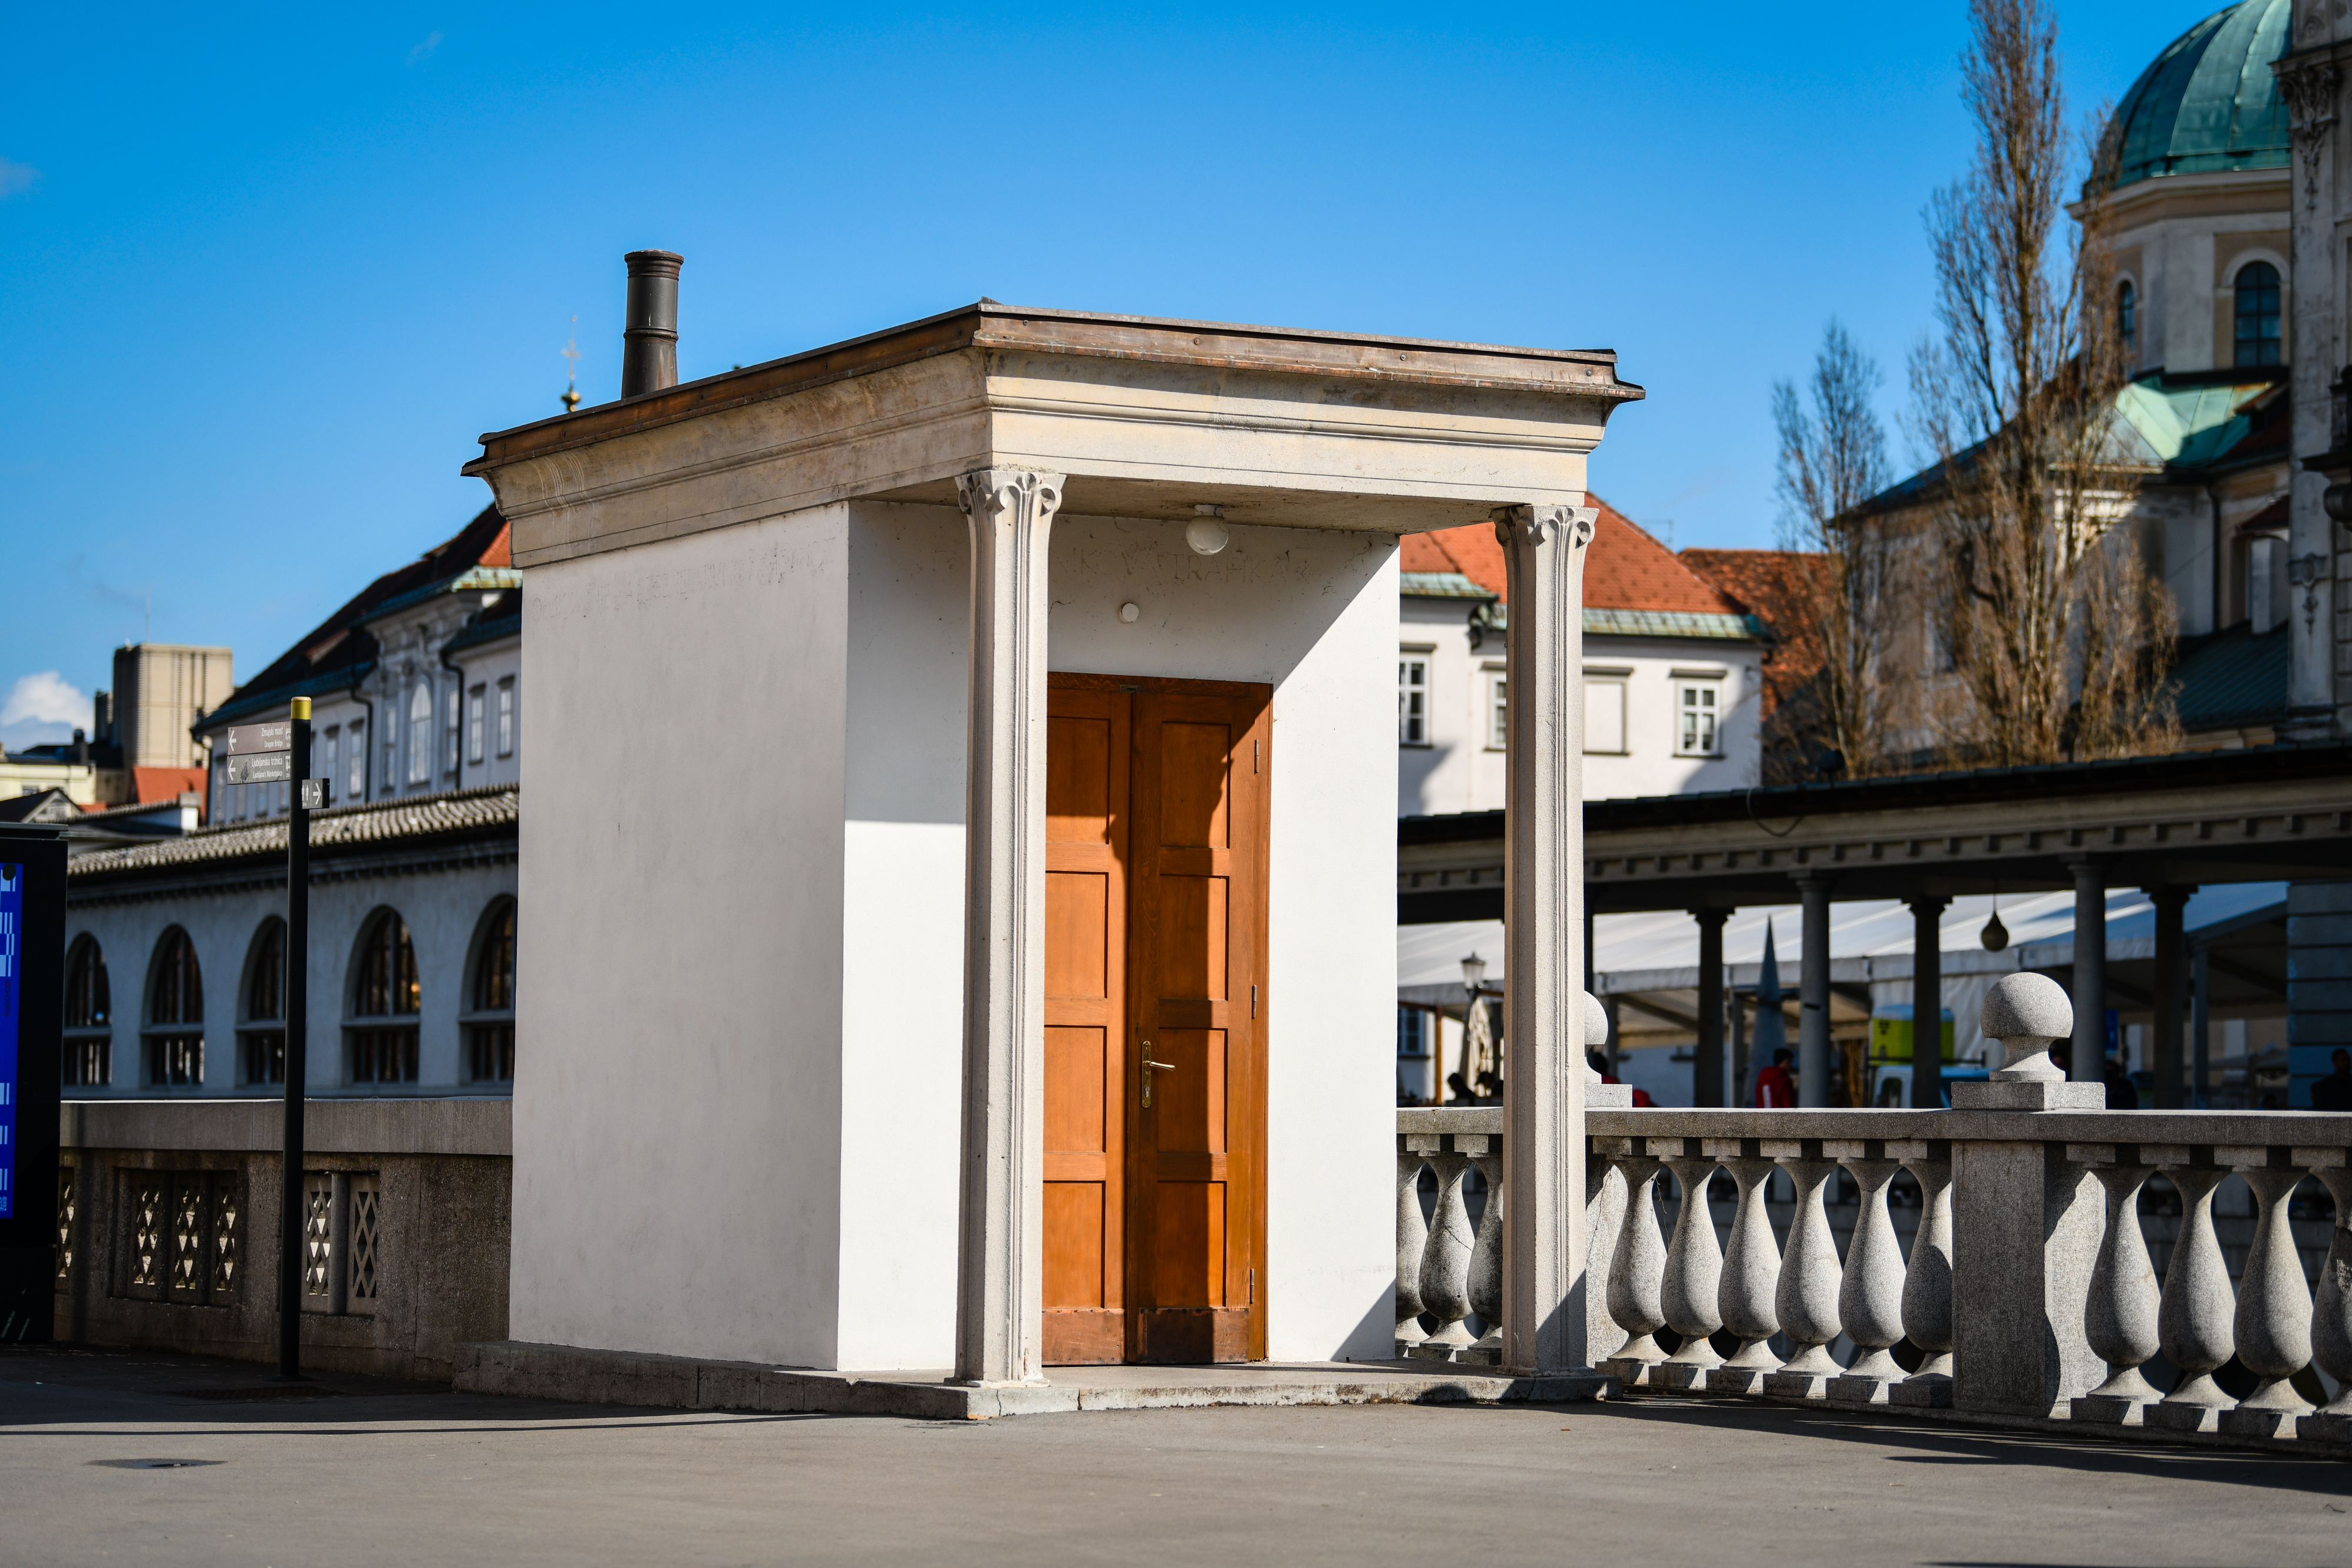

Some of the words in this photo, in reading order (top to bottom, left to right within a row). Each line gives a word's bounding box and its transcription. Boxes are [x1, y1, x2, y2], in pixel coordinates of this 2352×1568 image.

[261, 727, 274, 738] Zmajski
[275, 727, 283, 735] most
[264, 741, 274, 749] Dragon
[275, 740, 283, 748] Bridge
[252, 757, 271, 768] Ljubljanska
[271, 756, 283, 765] tržnica
